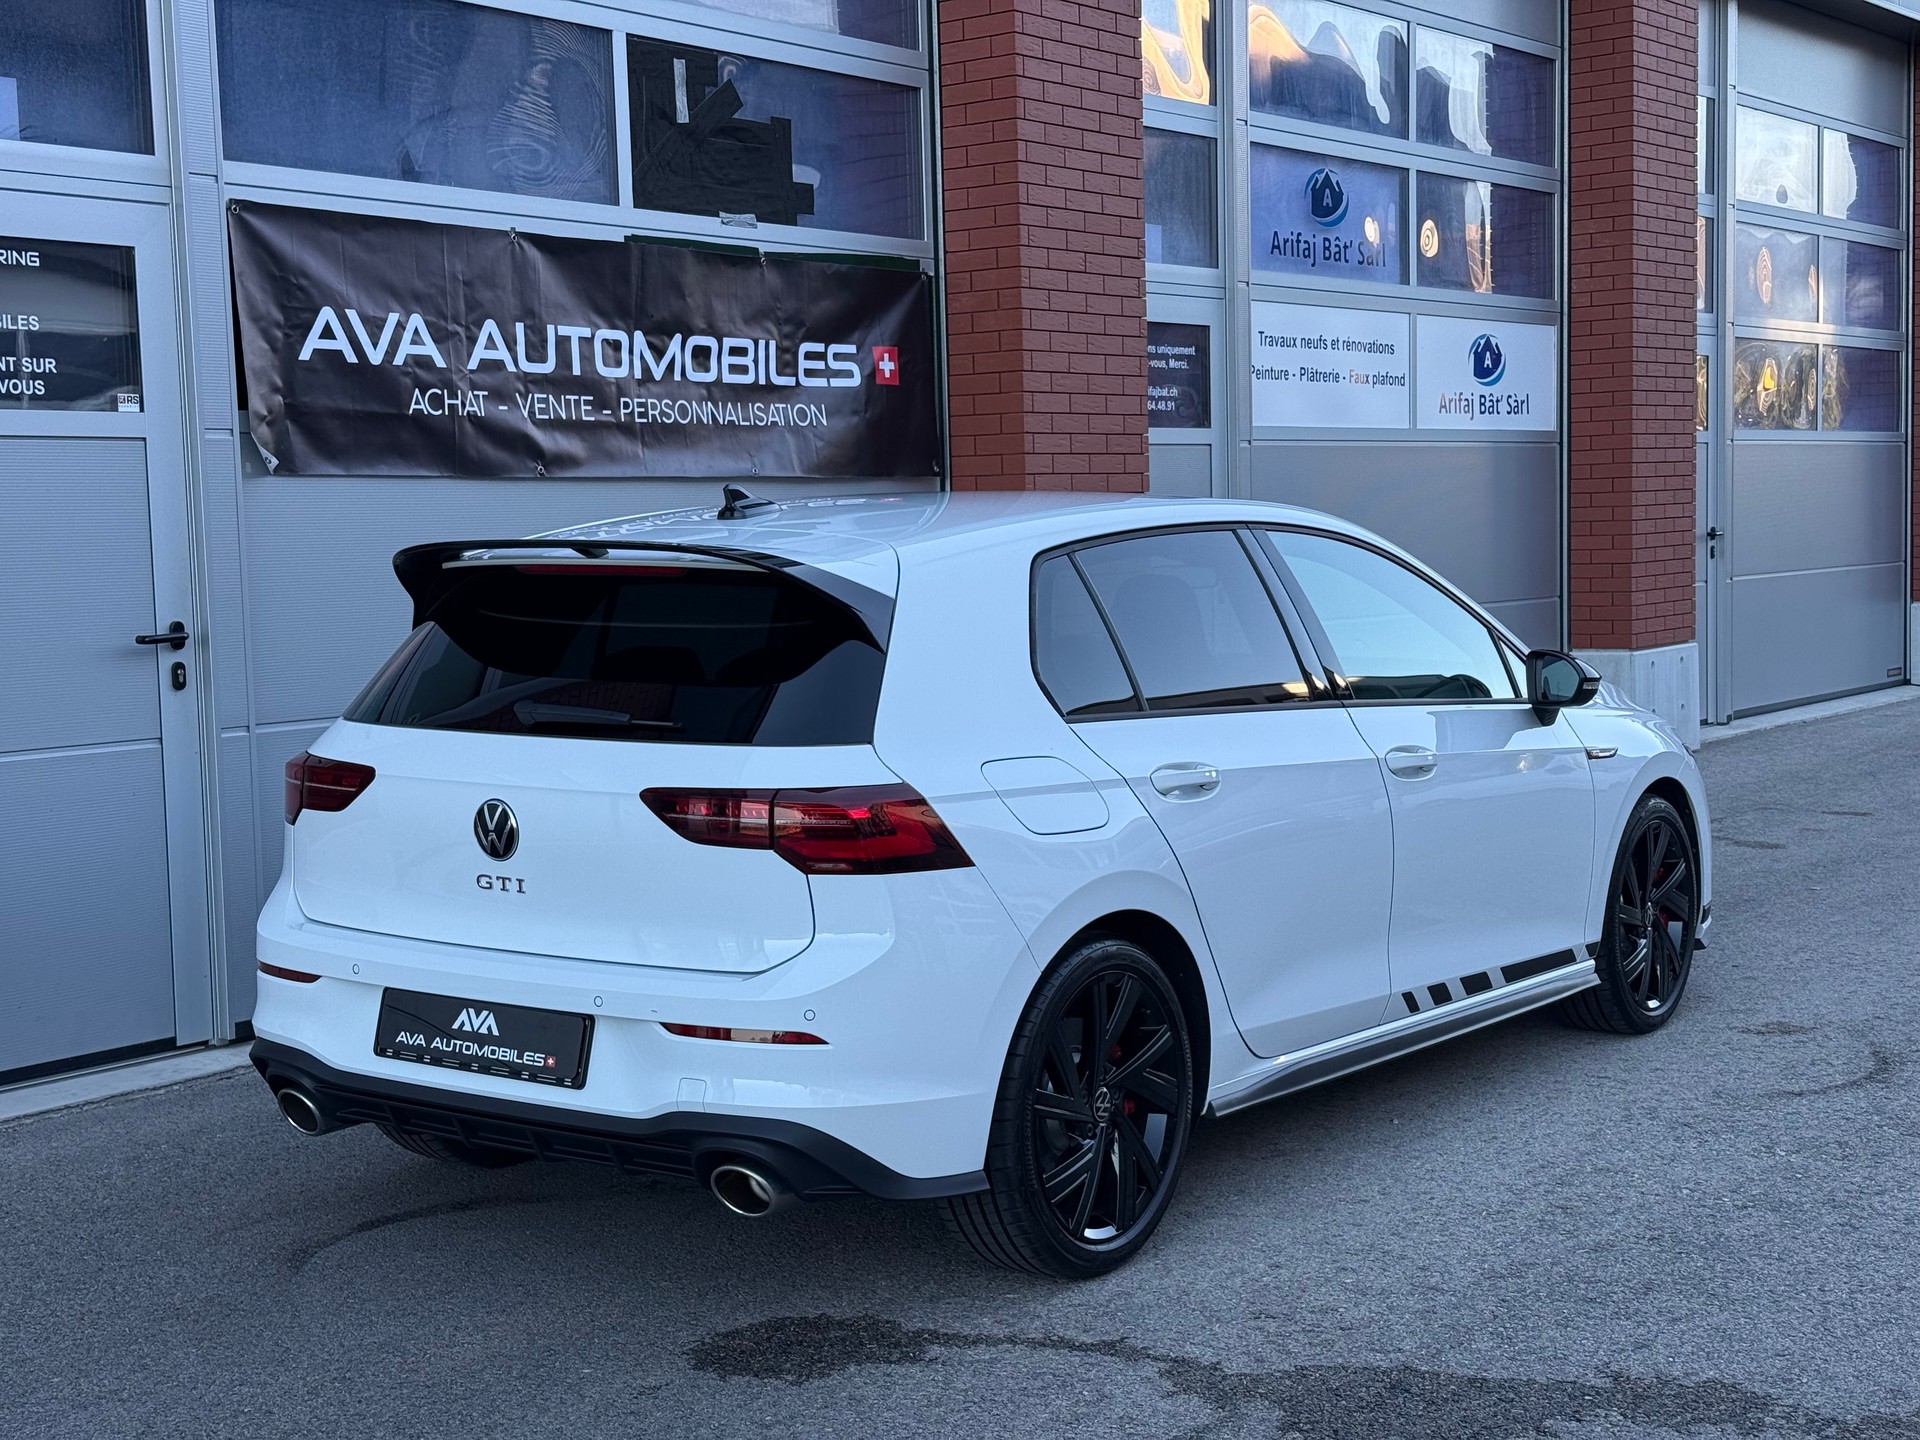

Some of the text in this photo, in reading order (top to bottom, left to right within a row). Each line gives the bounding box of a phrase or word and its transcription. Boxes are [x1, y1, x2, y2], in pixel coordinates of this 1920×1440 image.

[0, 249, 40, 266] RING
[1270, 230, 1316, 267] Arifaj
[0, 314, 40, 331] ILES
[298, 306, 862, 388] AVA AUTOMOBILES
[1156, 344, 1196, 357] uniquement
[1258, 330, 1395, 355] Travaux neufs et rénovations
[21, 357, 57, 374] SUR
[1168, 358, 1190, 370] Merci.
[1299, 366, 1340, 383] Plâtrerie
[1349, 368, 1370, 385] Faux
[1372, 370, 1406, 388] plafond
[408, 387, 488, 417] ACHAT
[515, 392, 596, 421] VENTE
[619, 397, 828, 427] PERSONNALISATION
[1438, 391, 1475, 421] Arifaj
[1506, 393, 1530, 415] Sàrl
[476, 873, 527, 894] GTI
[451, 1007, 500, 1036] AVA
[395, 1030, 546, 1066] AVA AUTOMOBILES
